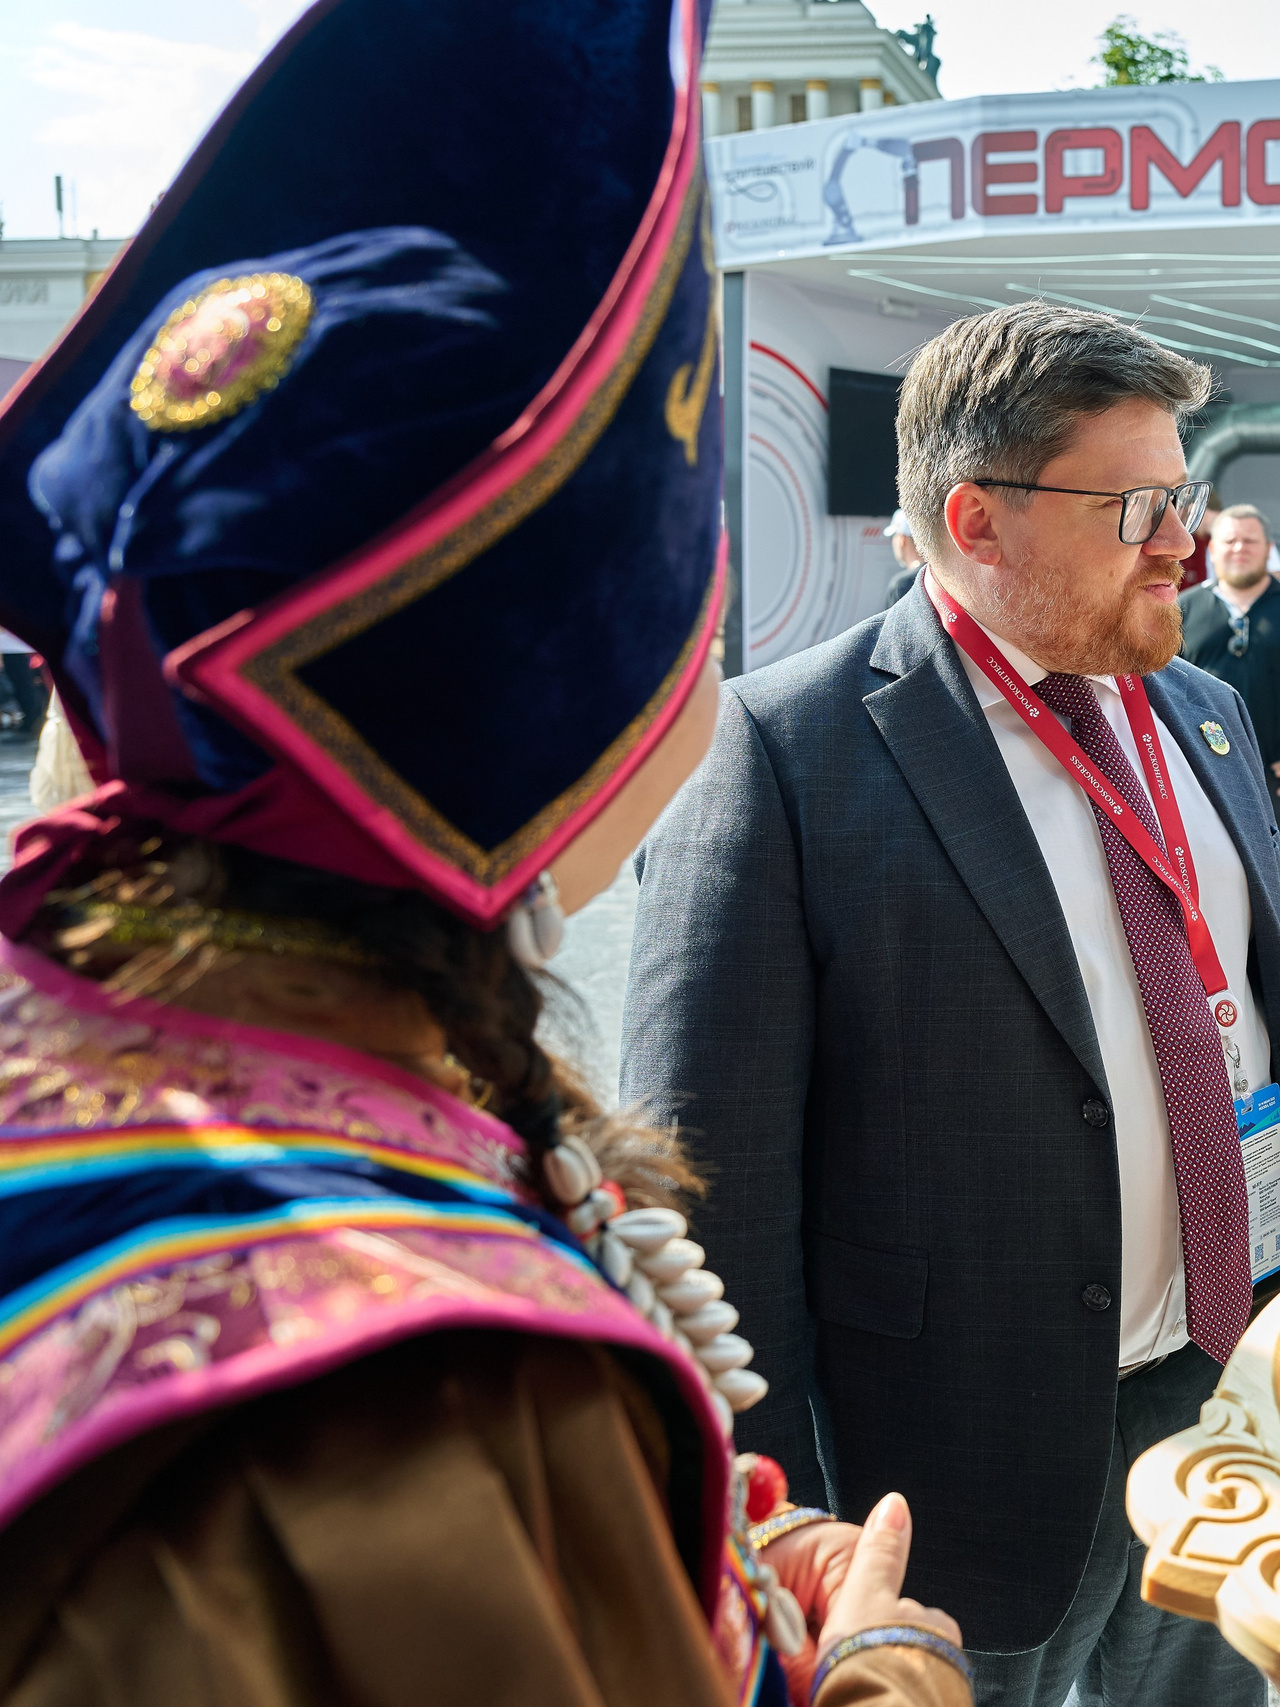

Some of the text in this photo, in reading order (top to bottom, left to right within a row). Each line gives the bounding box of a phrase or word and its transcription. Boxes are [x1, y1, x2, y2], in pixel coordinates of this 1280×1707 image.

[986, 655, 1032, 710] РОСКОНГРЕСС
[1069, 755, 1115, 807] ROSCONGRESS
[1145, 742, 1169, 800] РОСКОНГРЕСС
[1151, 855, 1194, 912] РОСКОНГРЕСС
